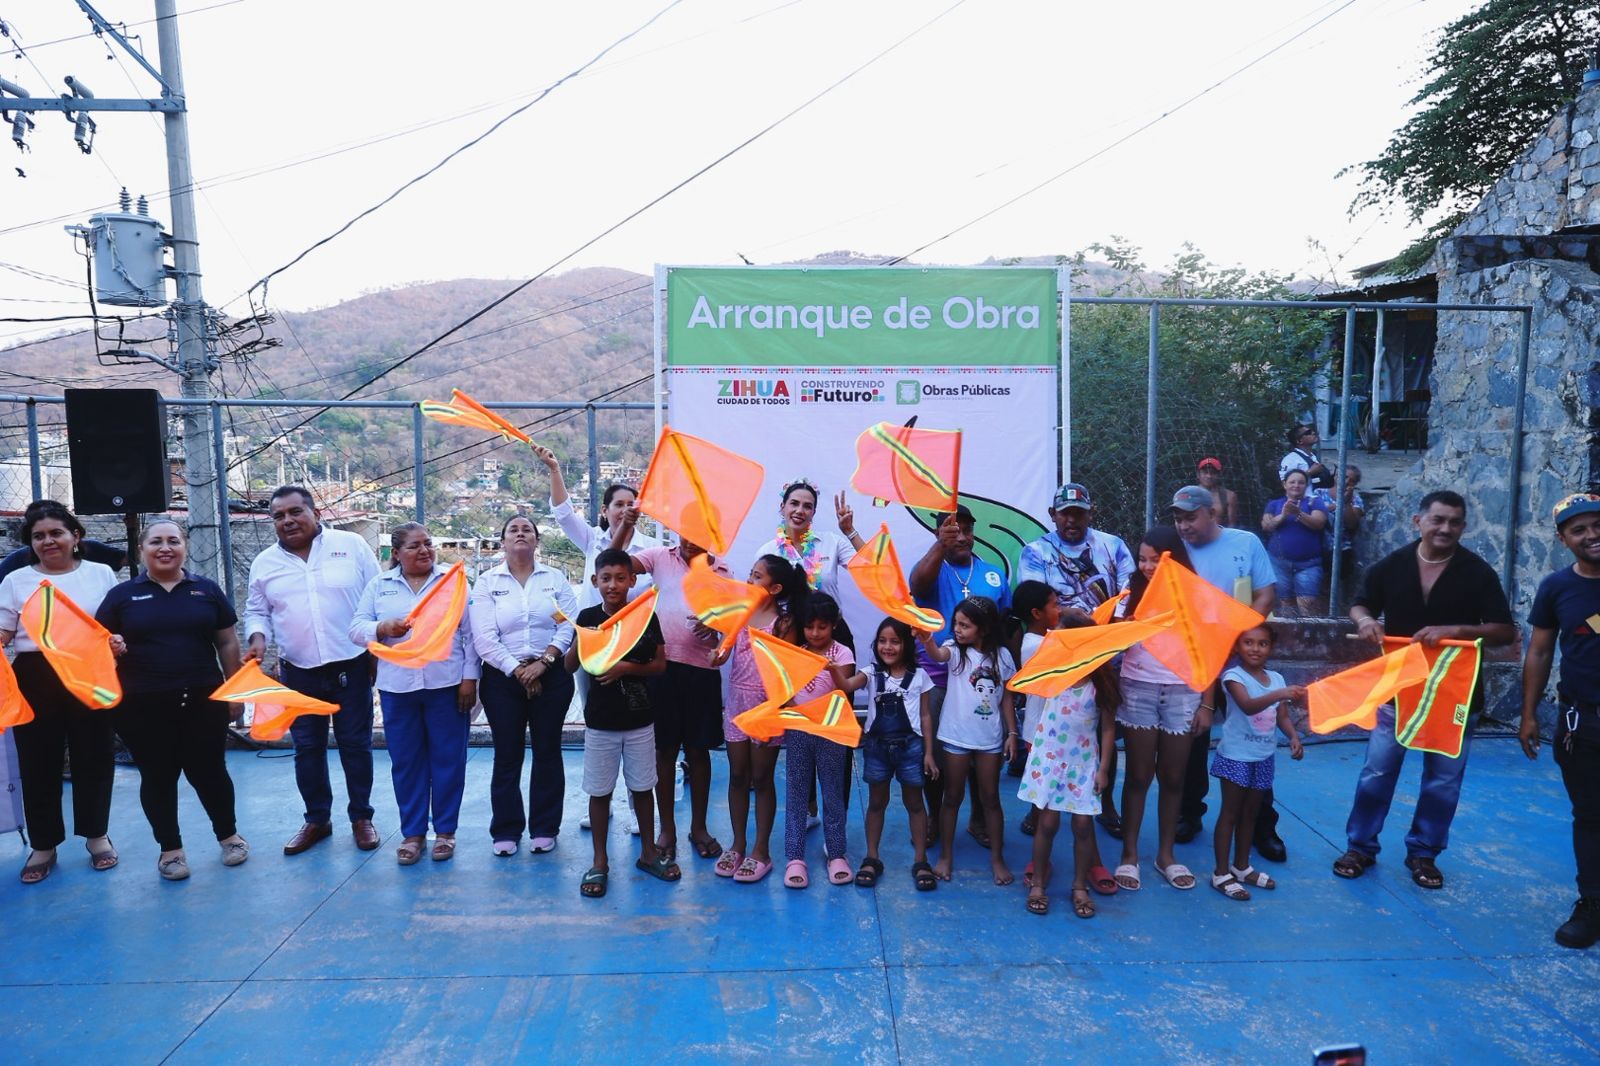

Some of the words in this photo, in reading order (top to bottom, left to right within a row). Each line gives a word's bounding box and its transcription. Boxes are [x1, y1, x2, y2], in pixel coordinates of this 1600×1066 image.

[687, 296, 873, 338] Arranque
[883, 296, 931, 329] de
[942, 296, 1040, 329] Obra
[718, 380, 790, 397] ZIHUA
[801, 380, 885, 389] CONSTRUYENDO
[922, 384, 959, 396] Obras
[961, 384, 1010, 396] Públicas
[814, 389, 872, 403] Futuro
